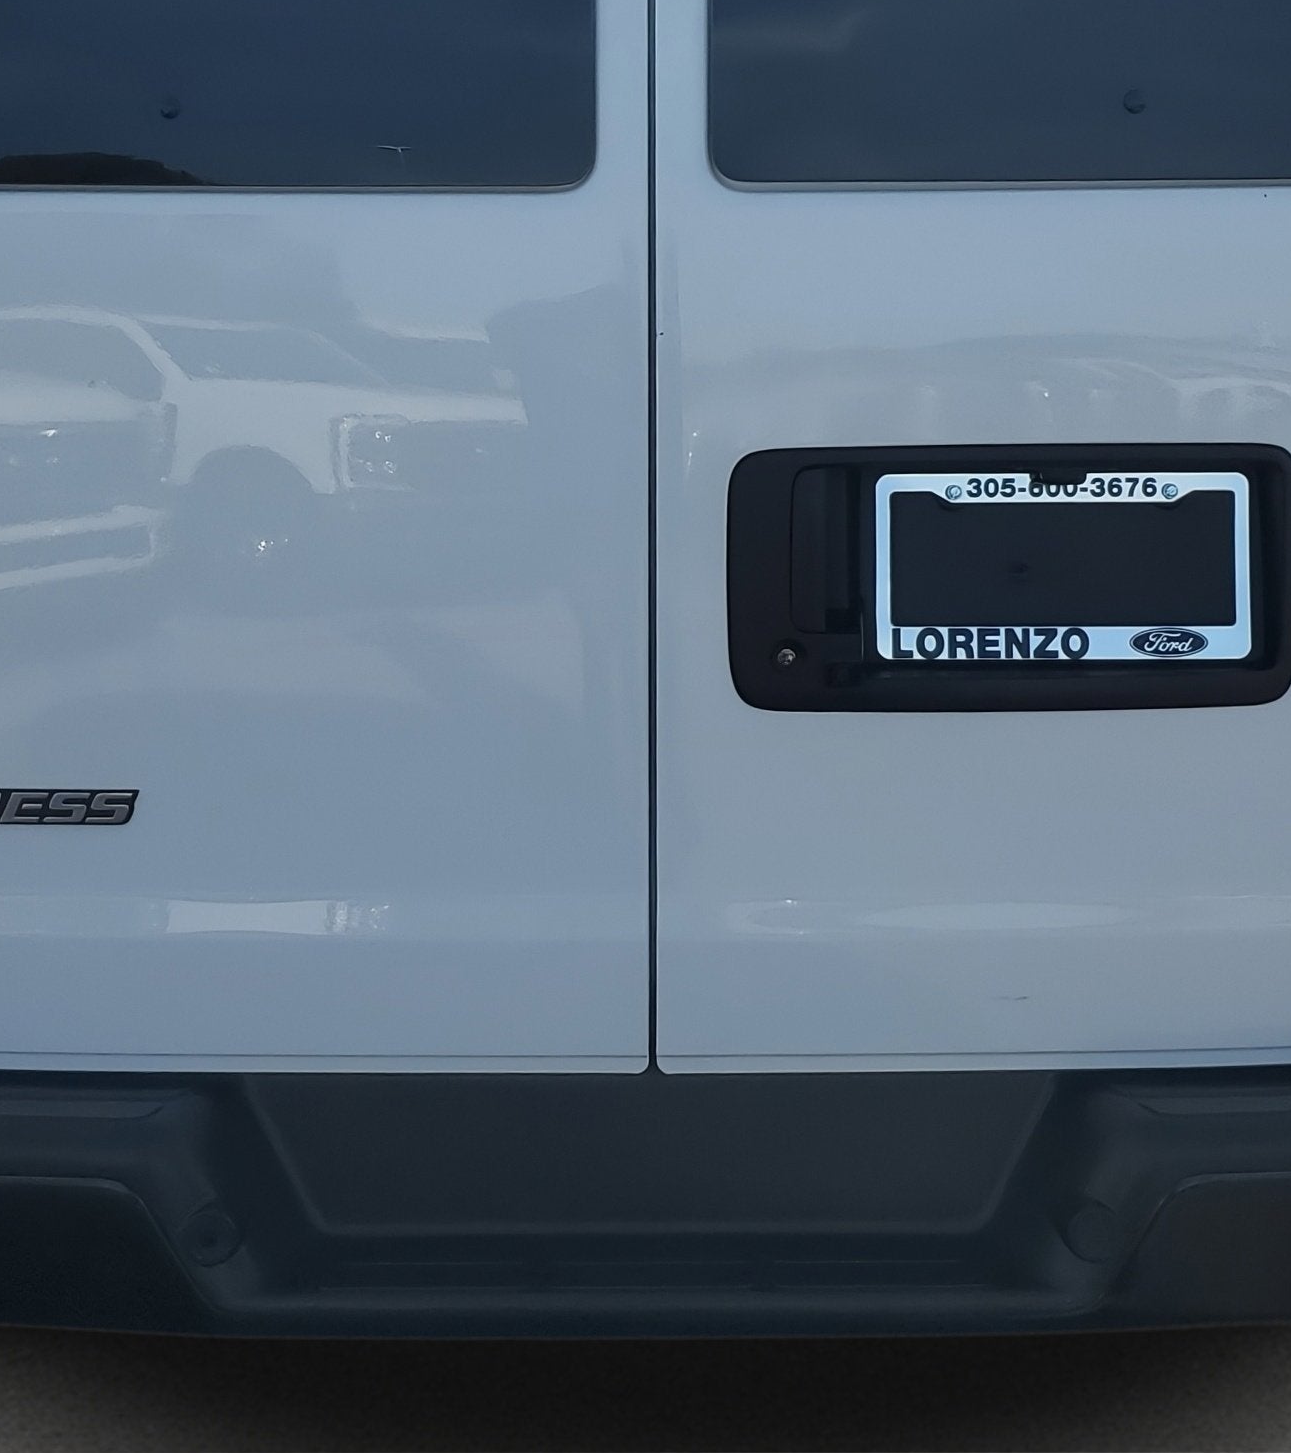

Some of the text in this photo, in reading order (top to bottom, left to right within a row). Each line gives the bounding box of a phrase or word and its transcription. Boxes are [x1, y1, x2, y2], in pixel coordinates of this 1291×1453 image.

[965, 477, 1158, 498] 305-600-3676
[891, 627, 1194, 659] LORENZO Ford
